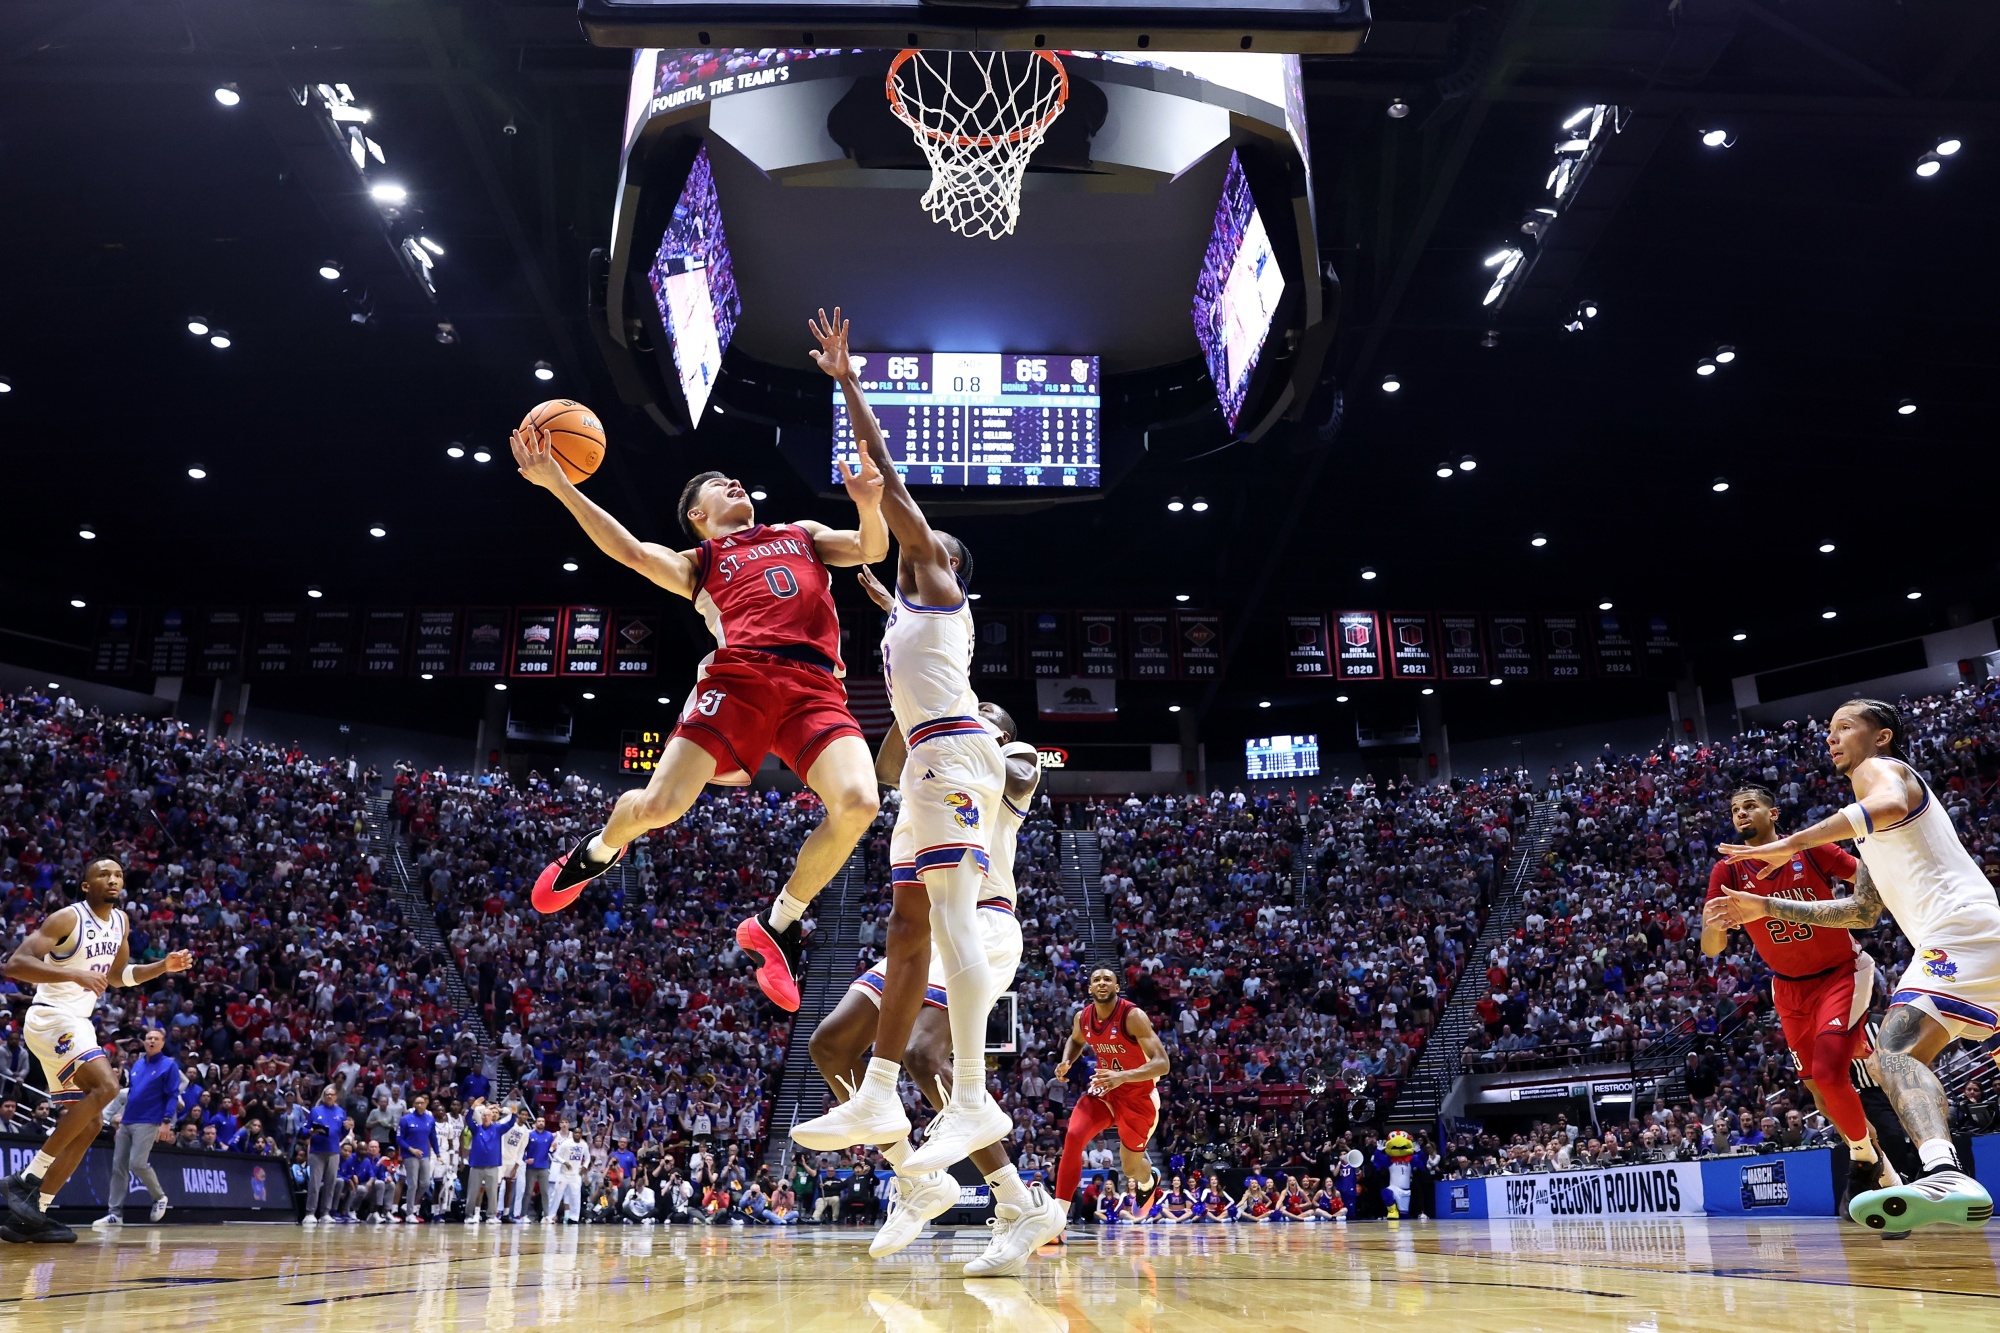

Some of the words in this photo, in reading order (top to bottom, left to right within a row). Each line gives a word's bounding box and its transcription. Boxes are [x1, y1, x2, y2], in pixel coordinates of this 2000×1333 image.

[652, 84, 706, 113] FOURTH,
[709, 76, 735, 96] THE
[737, 65, 790, 91] TEAM'S
[888, 357, 919, 380] 65
[1016, 359, 1047, 382] 65
[879, 382, 893, 390] FLS
[906, 382, 921, 391] TOL
[953, 376, 980, 393] 0.8
[1002, 383, 1028, 392] BONUS
[1045, 384, 1059, 392] FLS
[1072, 384, 1087, 393] TOL
[1057, 408, 1064, 418] 1
[1071, 420, 1078, 429] 1
[1057, 443, 1064, 453] 7
[1071, 443, 1078, 453] 1
[931, 474, 943, 485] 71
[719, 554, 745, 582] ST.
[747, 538, 815, 563] JOHN'S
[765, 565, 799, 599] 0
[420, 626, 452, 635] WAC
[1032, 650, 1053, 658] SWEET
[313, 659, 337, 669] 1977
[469, 662, 496, 671] 2002
[619, 661, 648, 671] 2009
[982, 664, 1008, 673] 2014
[1296, 662, 1322, 672] 2018
[1402, 664, 1427, 674] 2021
[1606, 663, 1632, 672] 2024
[1035, 665, 1060, 674] 2014
[1088, 665, 1113, 674] 2015
[1346, 665, 1373, 674] 2020
[1453, 665, 1476, 674] 2021
[1504, 666, 1529, 675] 2023
[1554, 667, 1579, 675] 2023
[697, 689, 727, 716] SJ
[643, 731, 660, 743] 0.7
[625, 747, 638, 758] 65
[1038, 751, 1062, 767] EJAS
[1765, 919, 1813, 944] 23
[86, 941, 120, 960] KANSA
[1096, 1043, 1126, 1054] JOHN'S
[1747, 1167, 1773, 1184] MARCH
[183, 1167, 228, 1195] KANSAS
[1506, 1179, 1536, 1215] FIRST
[1536, 1189, 1548, 1205] AND
[1549, 1174, 1603, 1215] SECOND
[1605, 1169, 1681, 1214] ROUNDS
[1752, 1182, 1788, 1200] MADNESS
[960, 1195, 989, 1205] ADNESS
